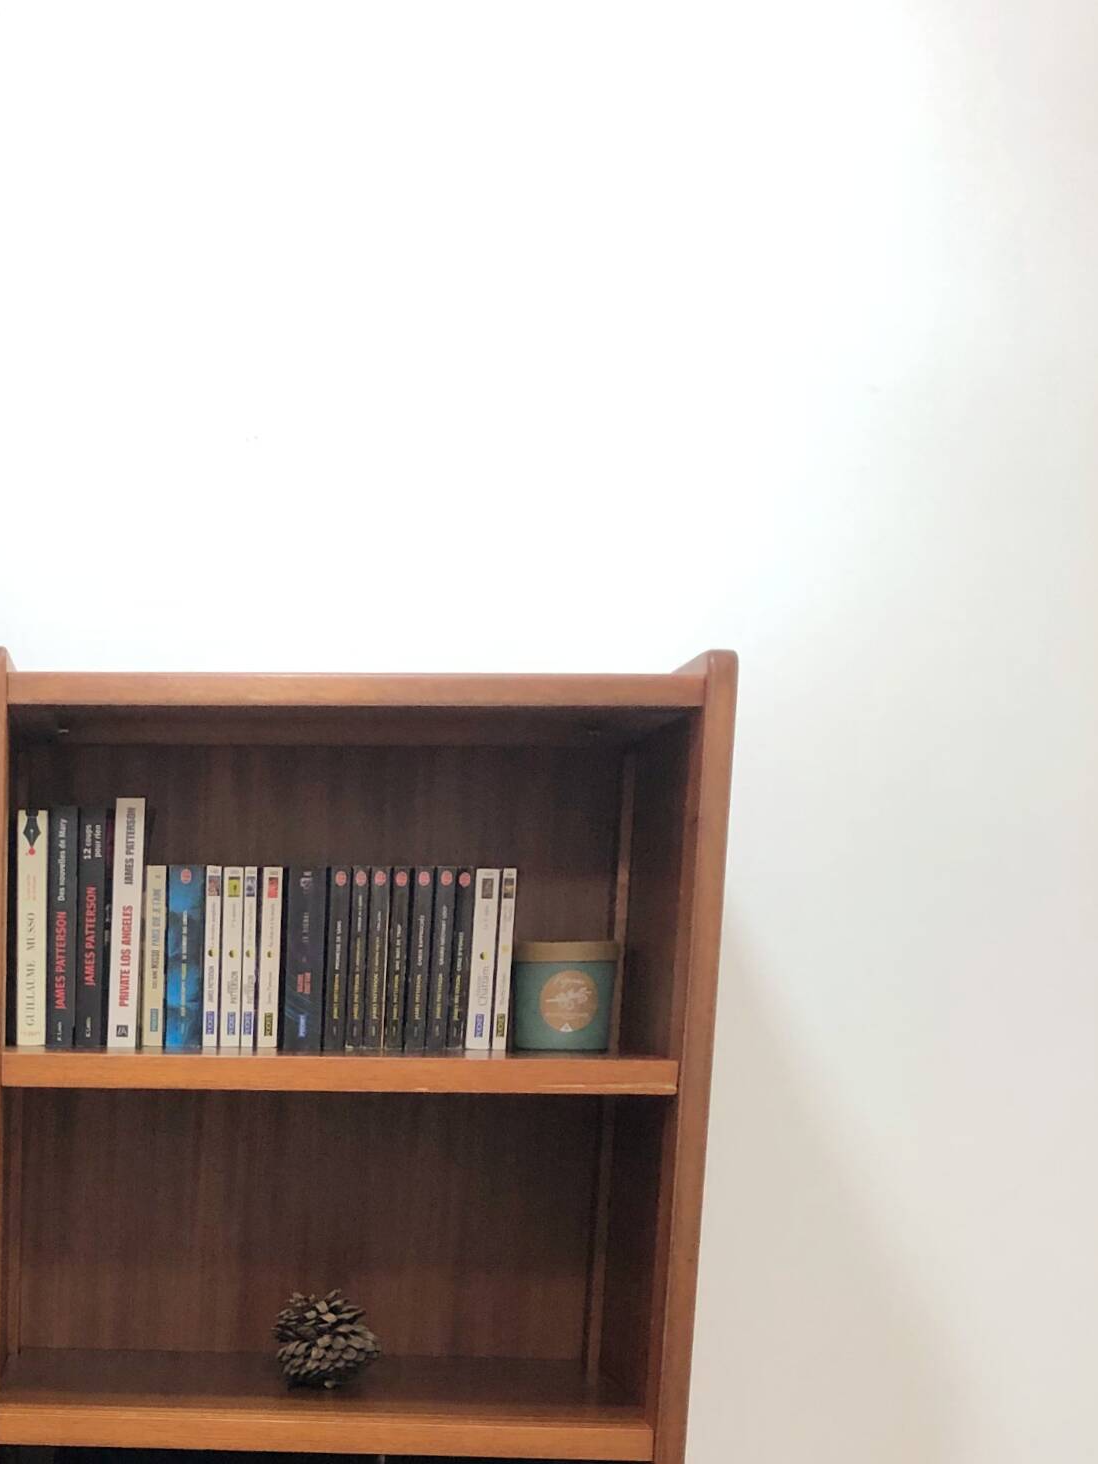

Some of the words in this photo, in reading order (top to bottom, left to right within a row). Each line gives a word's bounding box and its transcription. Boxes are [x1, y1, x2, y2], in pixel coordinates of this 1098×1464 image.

[58, 839, 66, 848] de
[59, 819, 68, 837] Mary
[85, 825, 93, 846] coups
[94, 825, 102, 839] rien
[124, 807, 136, 855] PATTERSON
[58, 850, 66, 886] nouvelles
[83, 848, 92, 859] 12
[123, 858, 134, 885] JAMES
[25, 912, 36, 951] MUSSO
[86, 887, 96, 949] PATTERSON
[121, 905, 133, 946] ANGELES
[55, 911, 67, 972] PATTERSON
[120, 948, 131, 967] LOS
[84, 951, 96, 986] JAMES
[150, 950, 159, 969] MUSSO
[25, 960, 35, 1026] GUILLAUME
[55, 976, 66, 1009] JAMES
[119, 970, 130, 1007] PRIVATE
[230, 971, 238, 1004] PATTERSON
